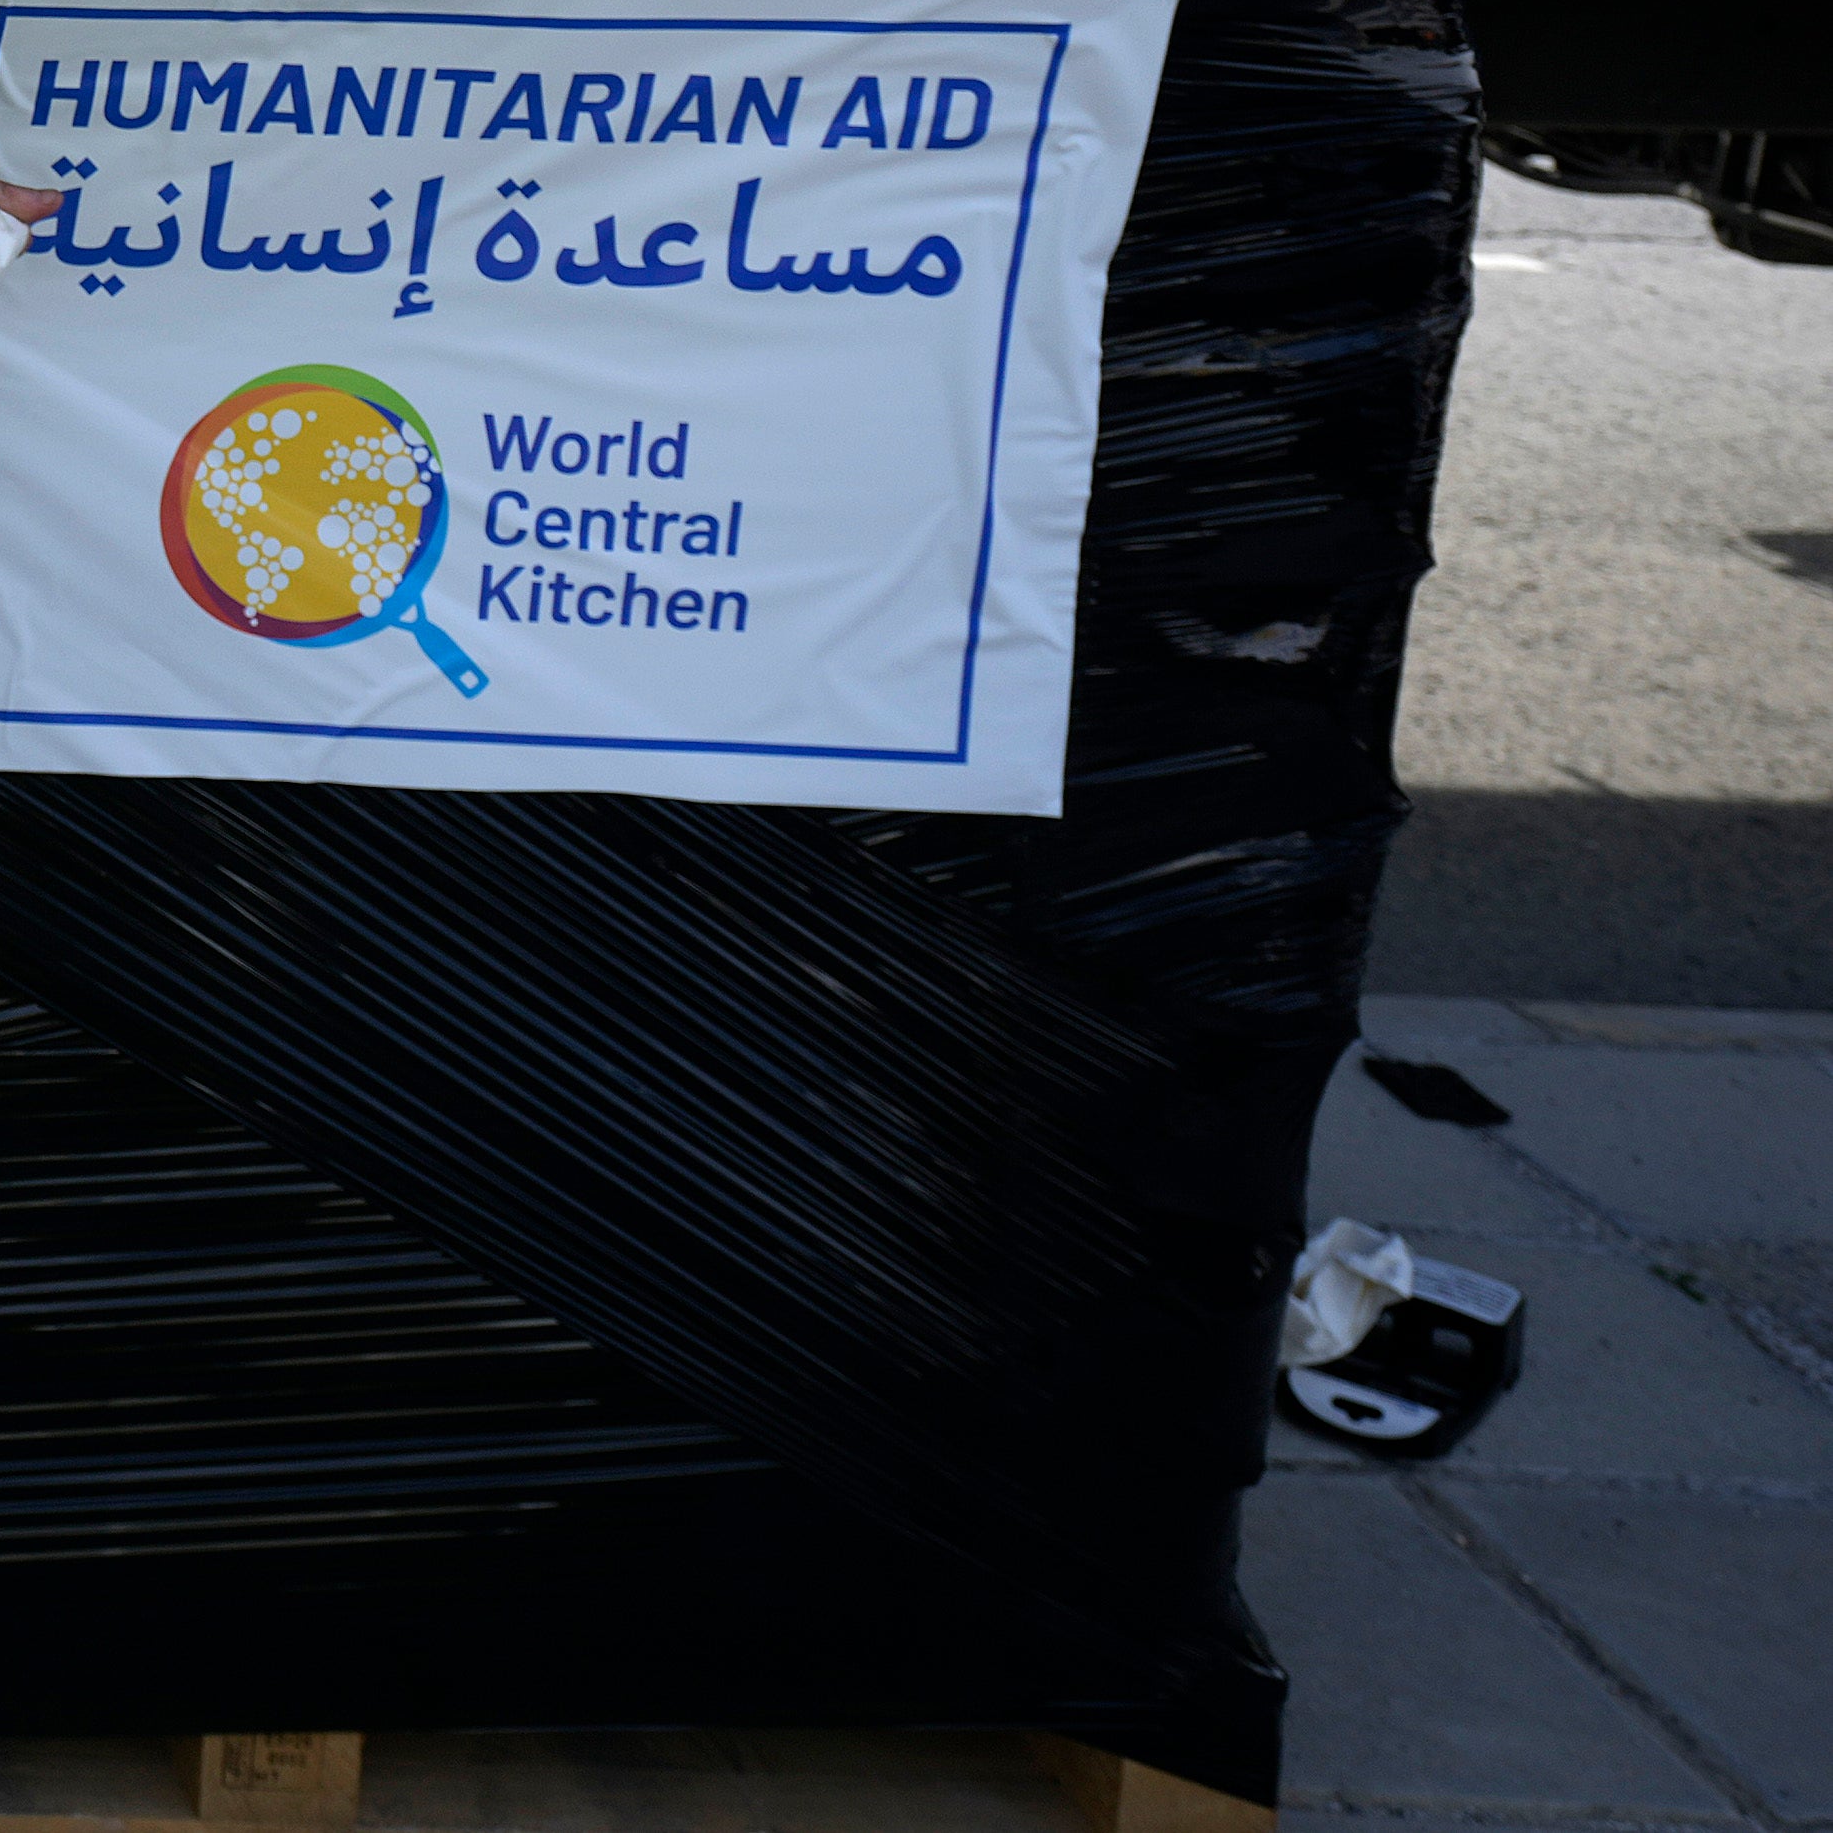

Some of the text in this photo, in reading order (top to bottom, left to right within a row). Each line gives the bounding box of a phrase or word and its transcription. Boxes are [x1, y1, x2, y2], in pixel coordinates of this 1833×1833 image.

[30, 59, 995, 152] HUMANITARIAN AID
[474, 176, 964, 299] مساعدة
[482, 412, 690, 481] World
[484, 489, 744, 559] Central
[477, 564, 750, 633] Kitchen
